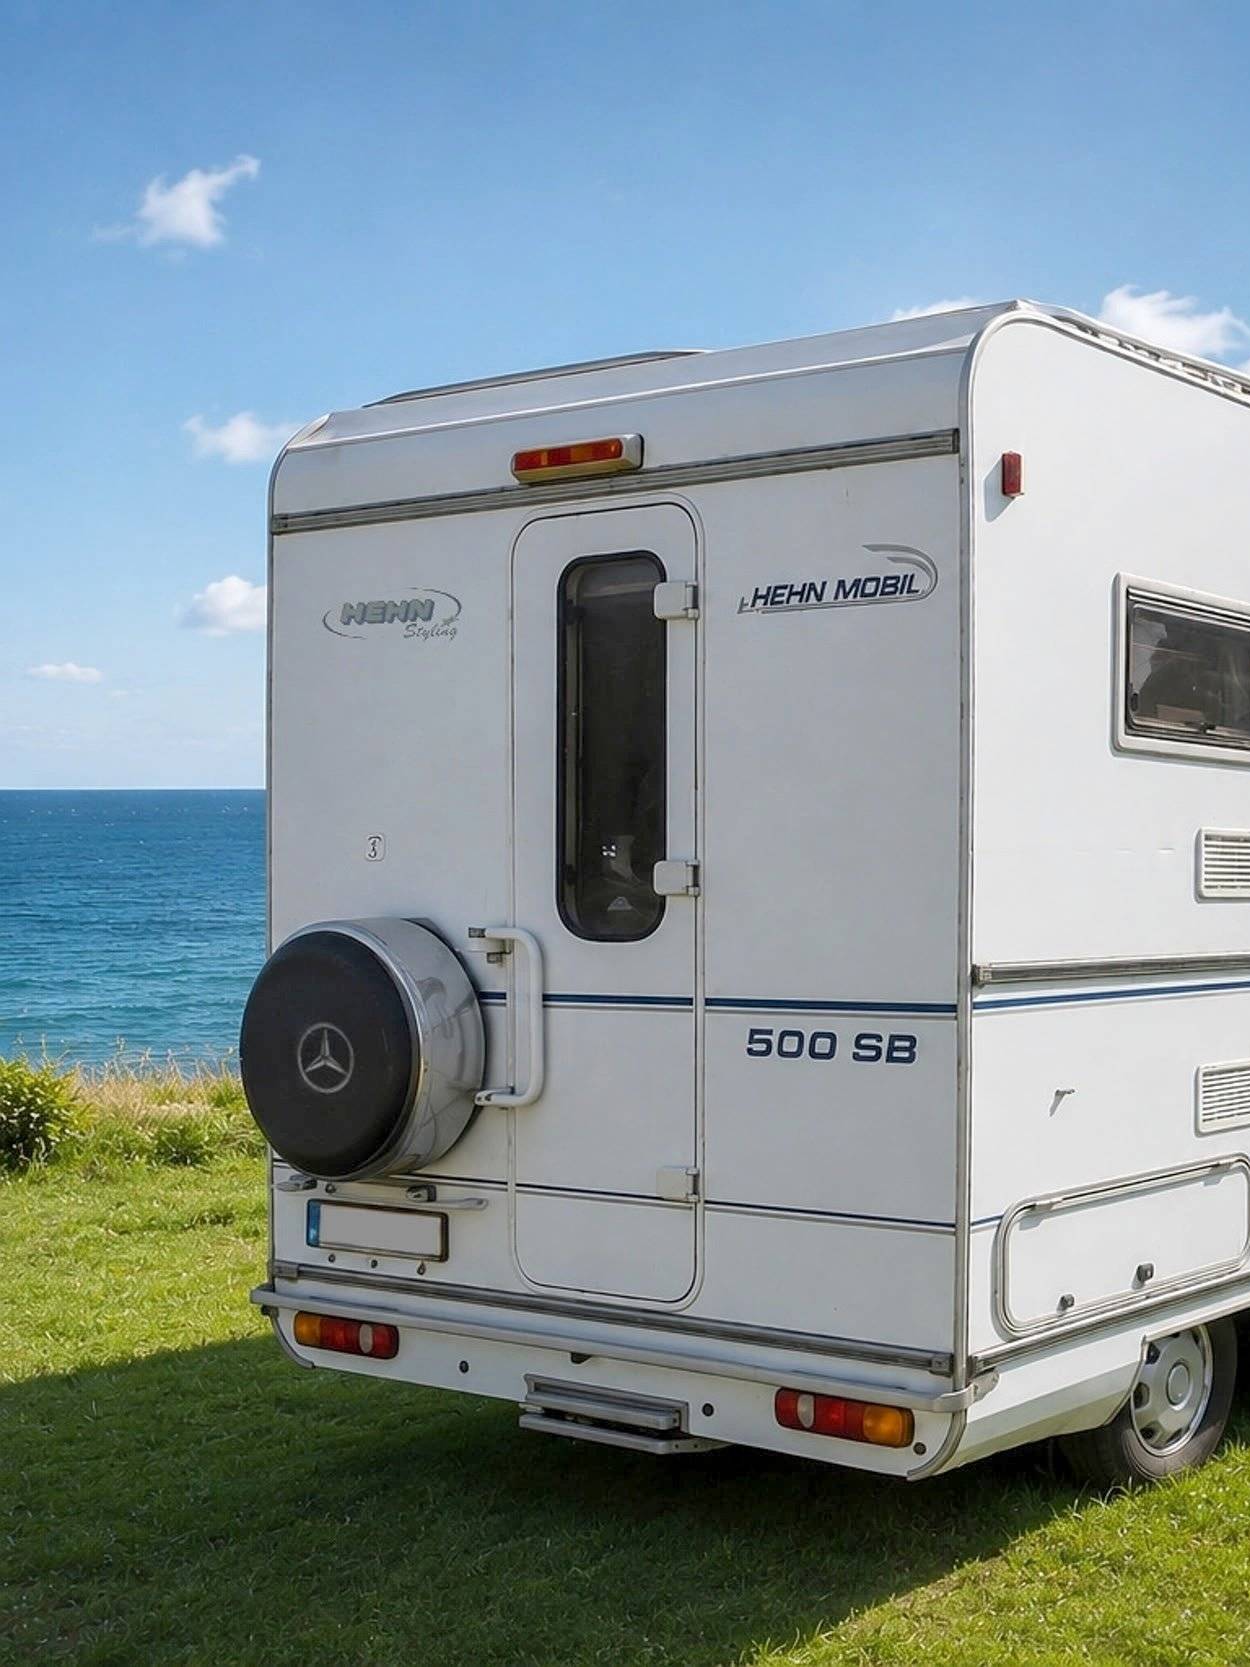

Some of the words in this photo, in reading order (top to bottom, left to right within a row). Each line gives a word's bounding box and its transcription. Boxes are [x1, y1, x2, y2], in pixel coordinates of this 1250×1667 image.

[751, 581, 827, 607] HEHN
[833, 573, 919, 601] MOBIL
[340, 599, 435, 625] HEHN
[403, 623, 457, 640] Styling
[746, 1028, 837, 1060] 500
[852, 1032, 917, 1064] SB
